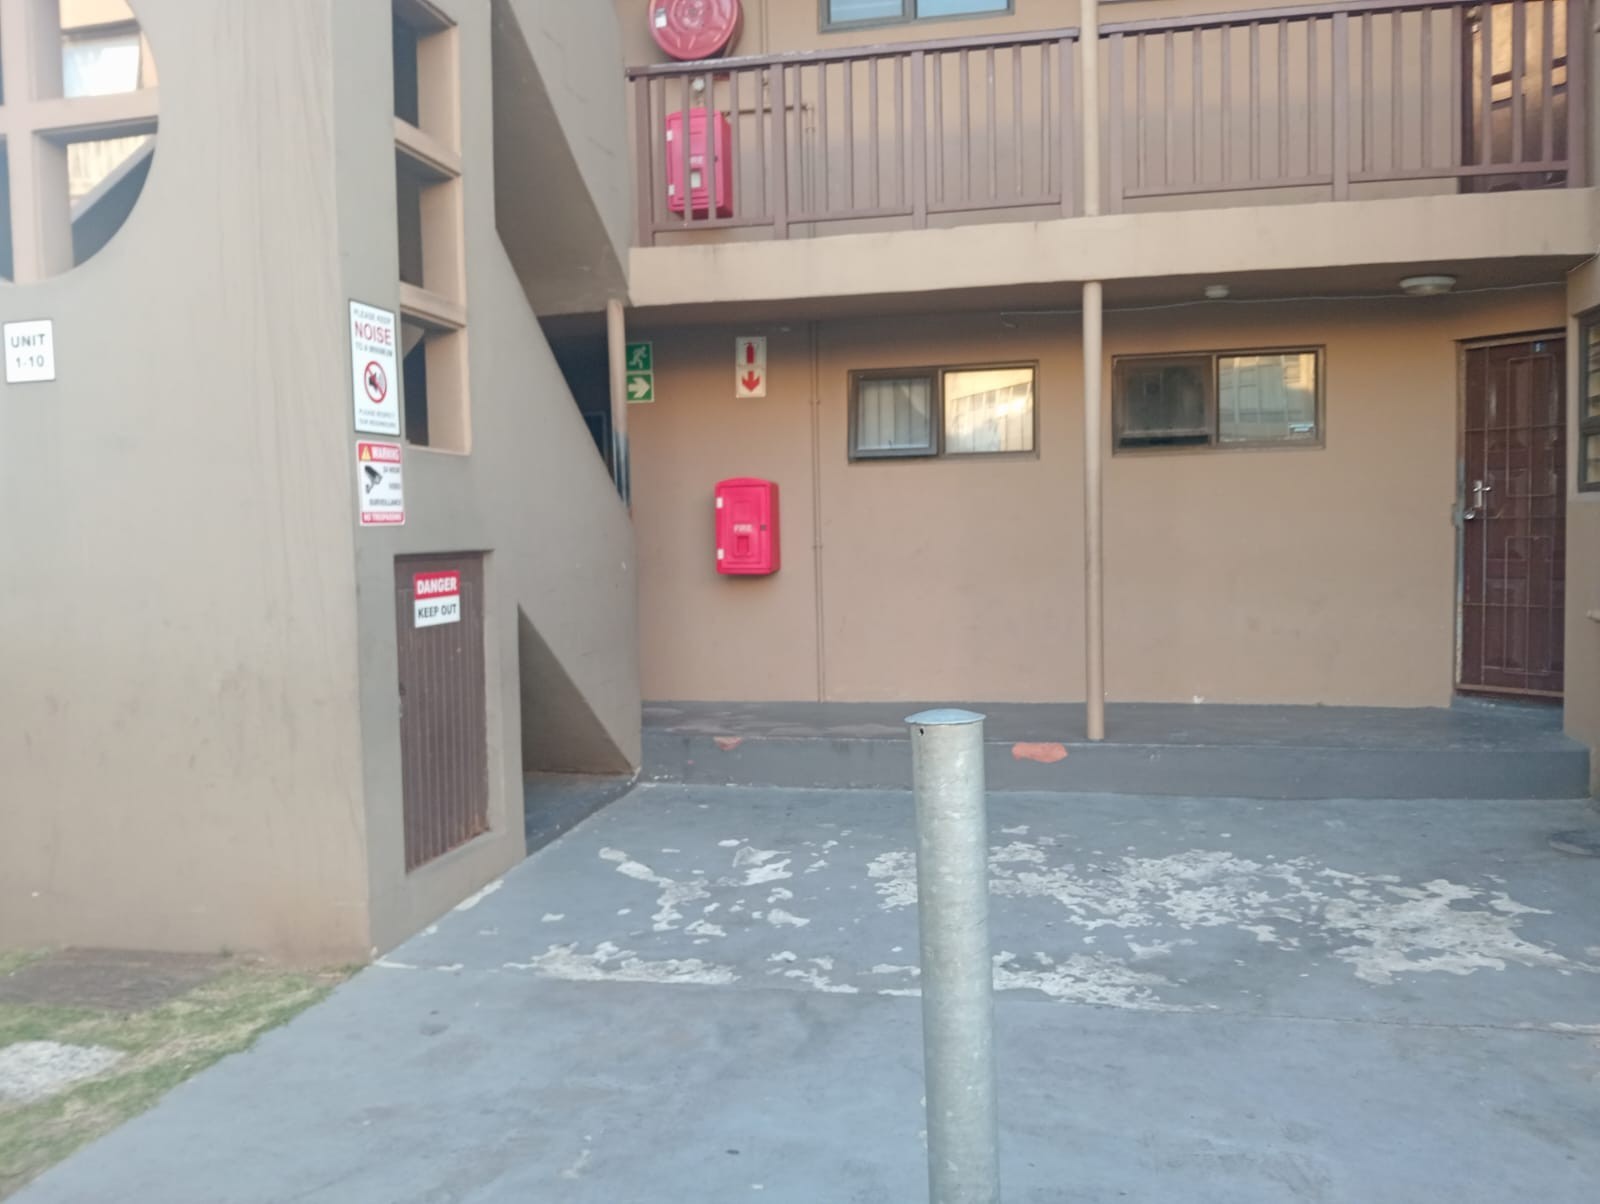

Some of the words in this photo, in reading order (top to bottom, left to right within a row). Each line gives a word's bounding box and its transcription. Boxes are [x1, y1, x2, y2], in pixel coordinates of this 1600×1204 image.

[11, 333, 46, 348] UNIT
[354, 320, 391, 346] NOISE
[417, 577, 457, 594] DANGER
[418, 606, 439, 618] KEEP
[441, 603, 457, 616] OUT
